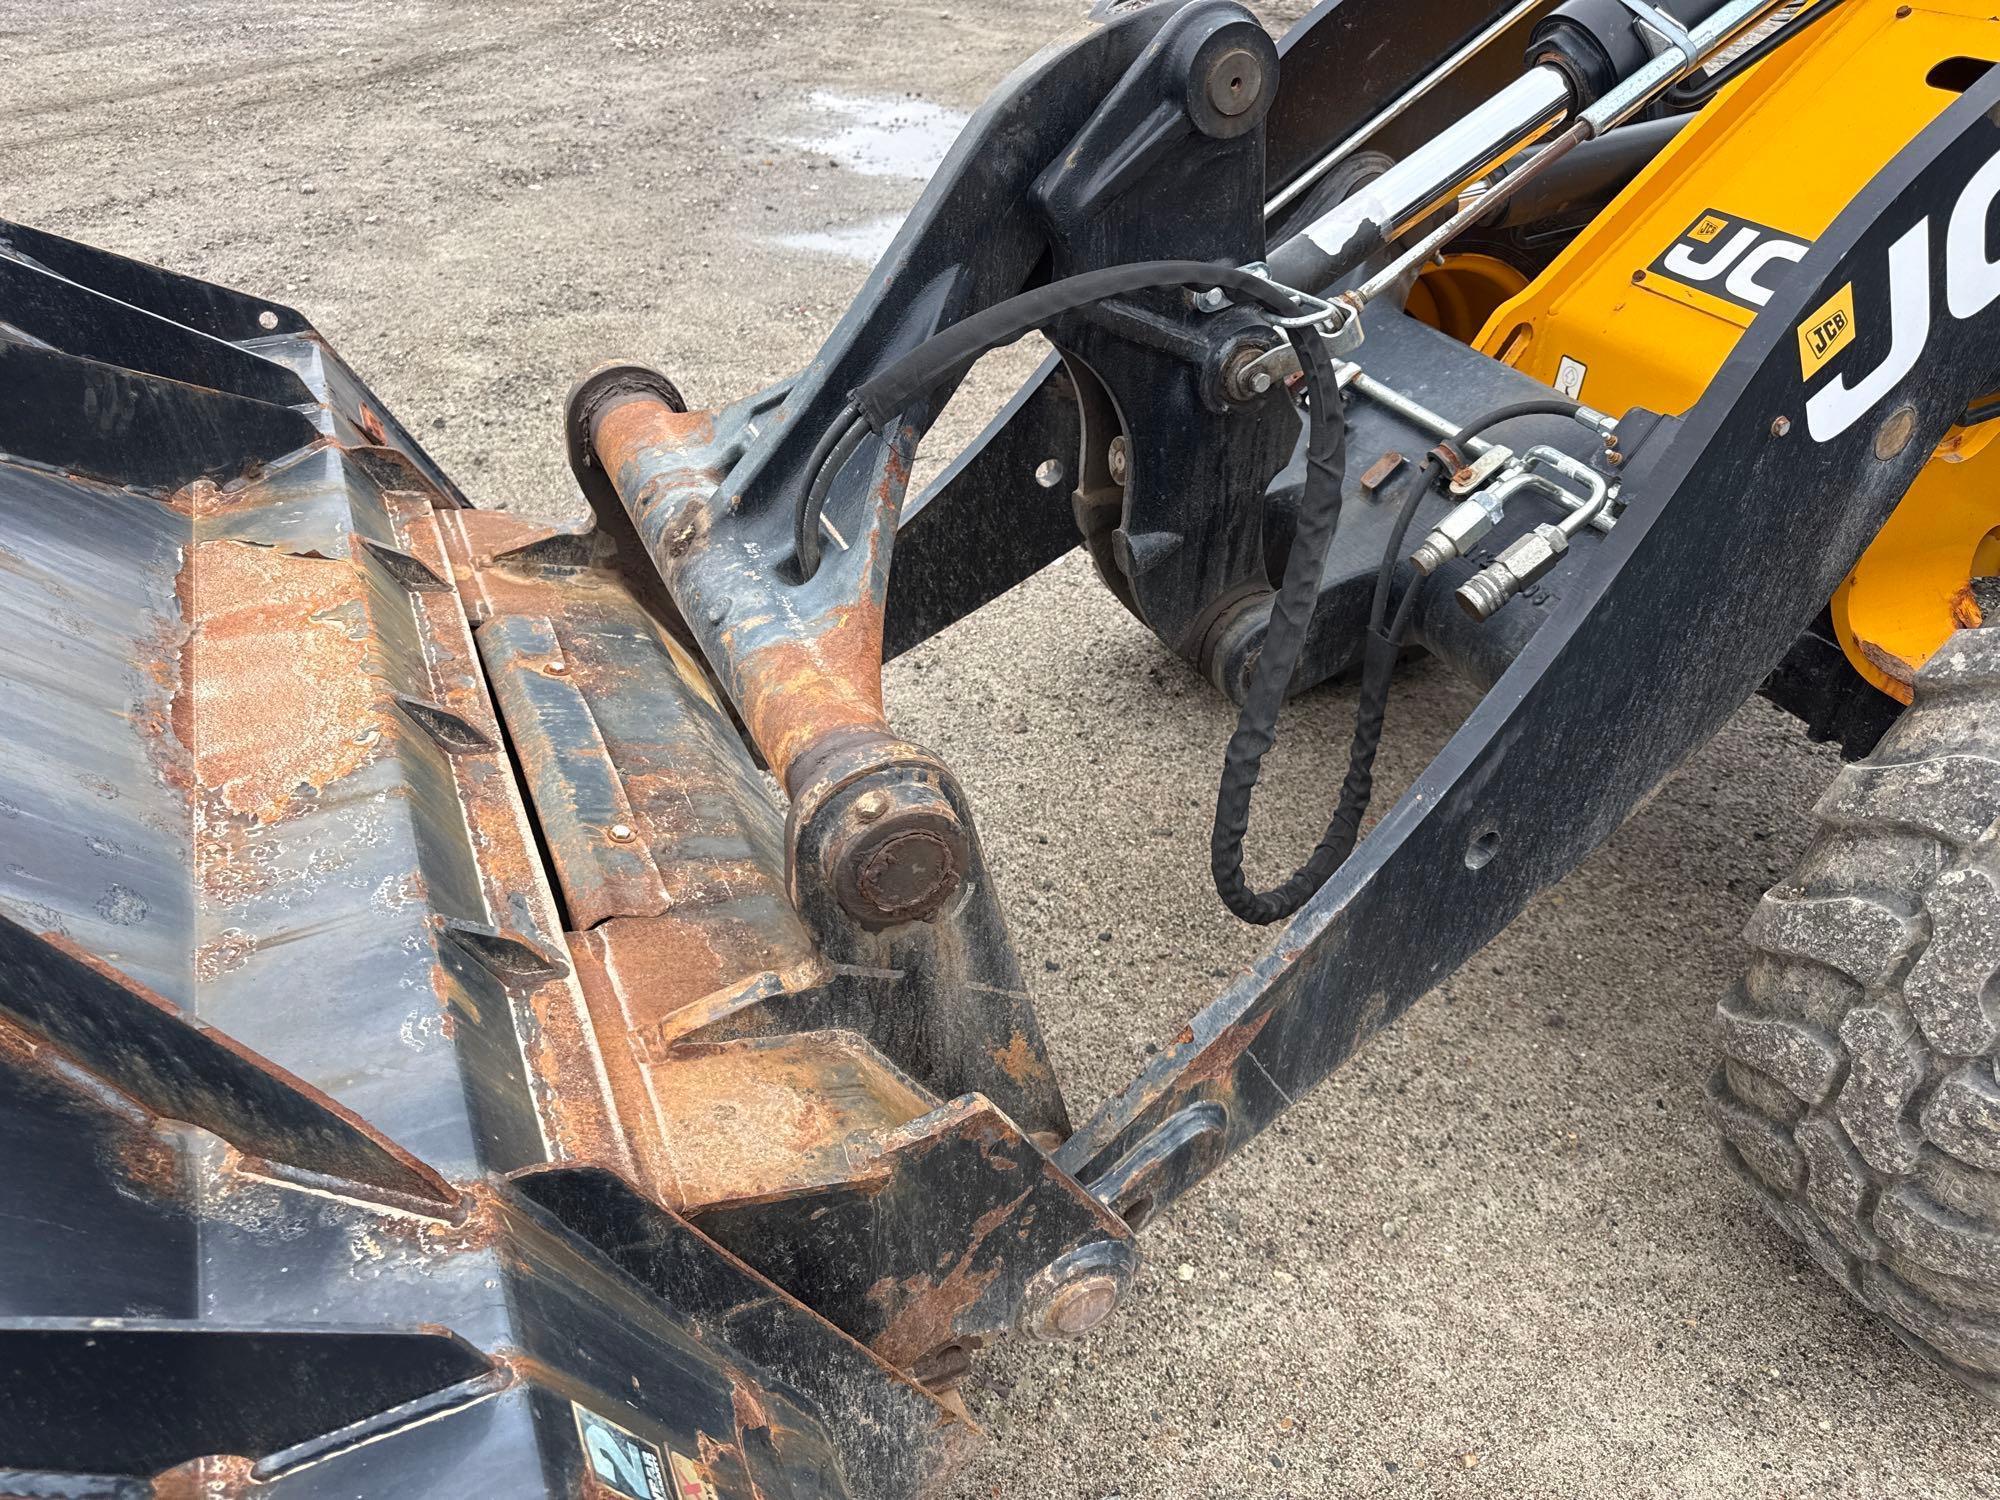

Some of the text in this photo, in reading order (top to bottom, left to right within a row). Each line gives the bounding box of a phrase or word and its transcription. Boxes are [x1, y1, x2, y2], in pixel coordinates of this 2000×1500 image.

[1699, 223, 1716, 234] JCB
[1811, 312, 1845, 355] JCB
[585, 1424, 650, 1500] 2
